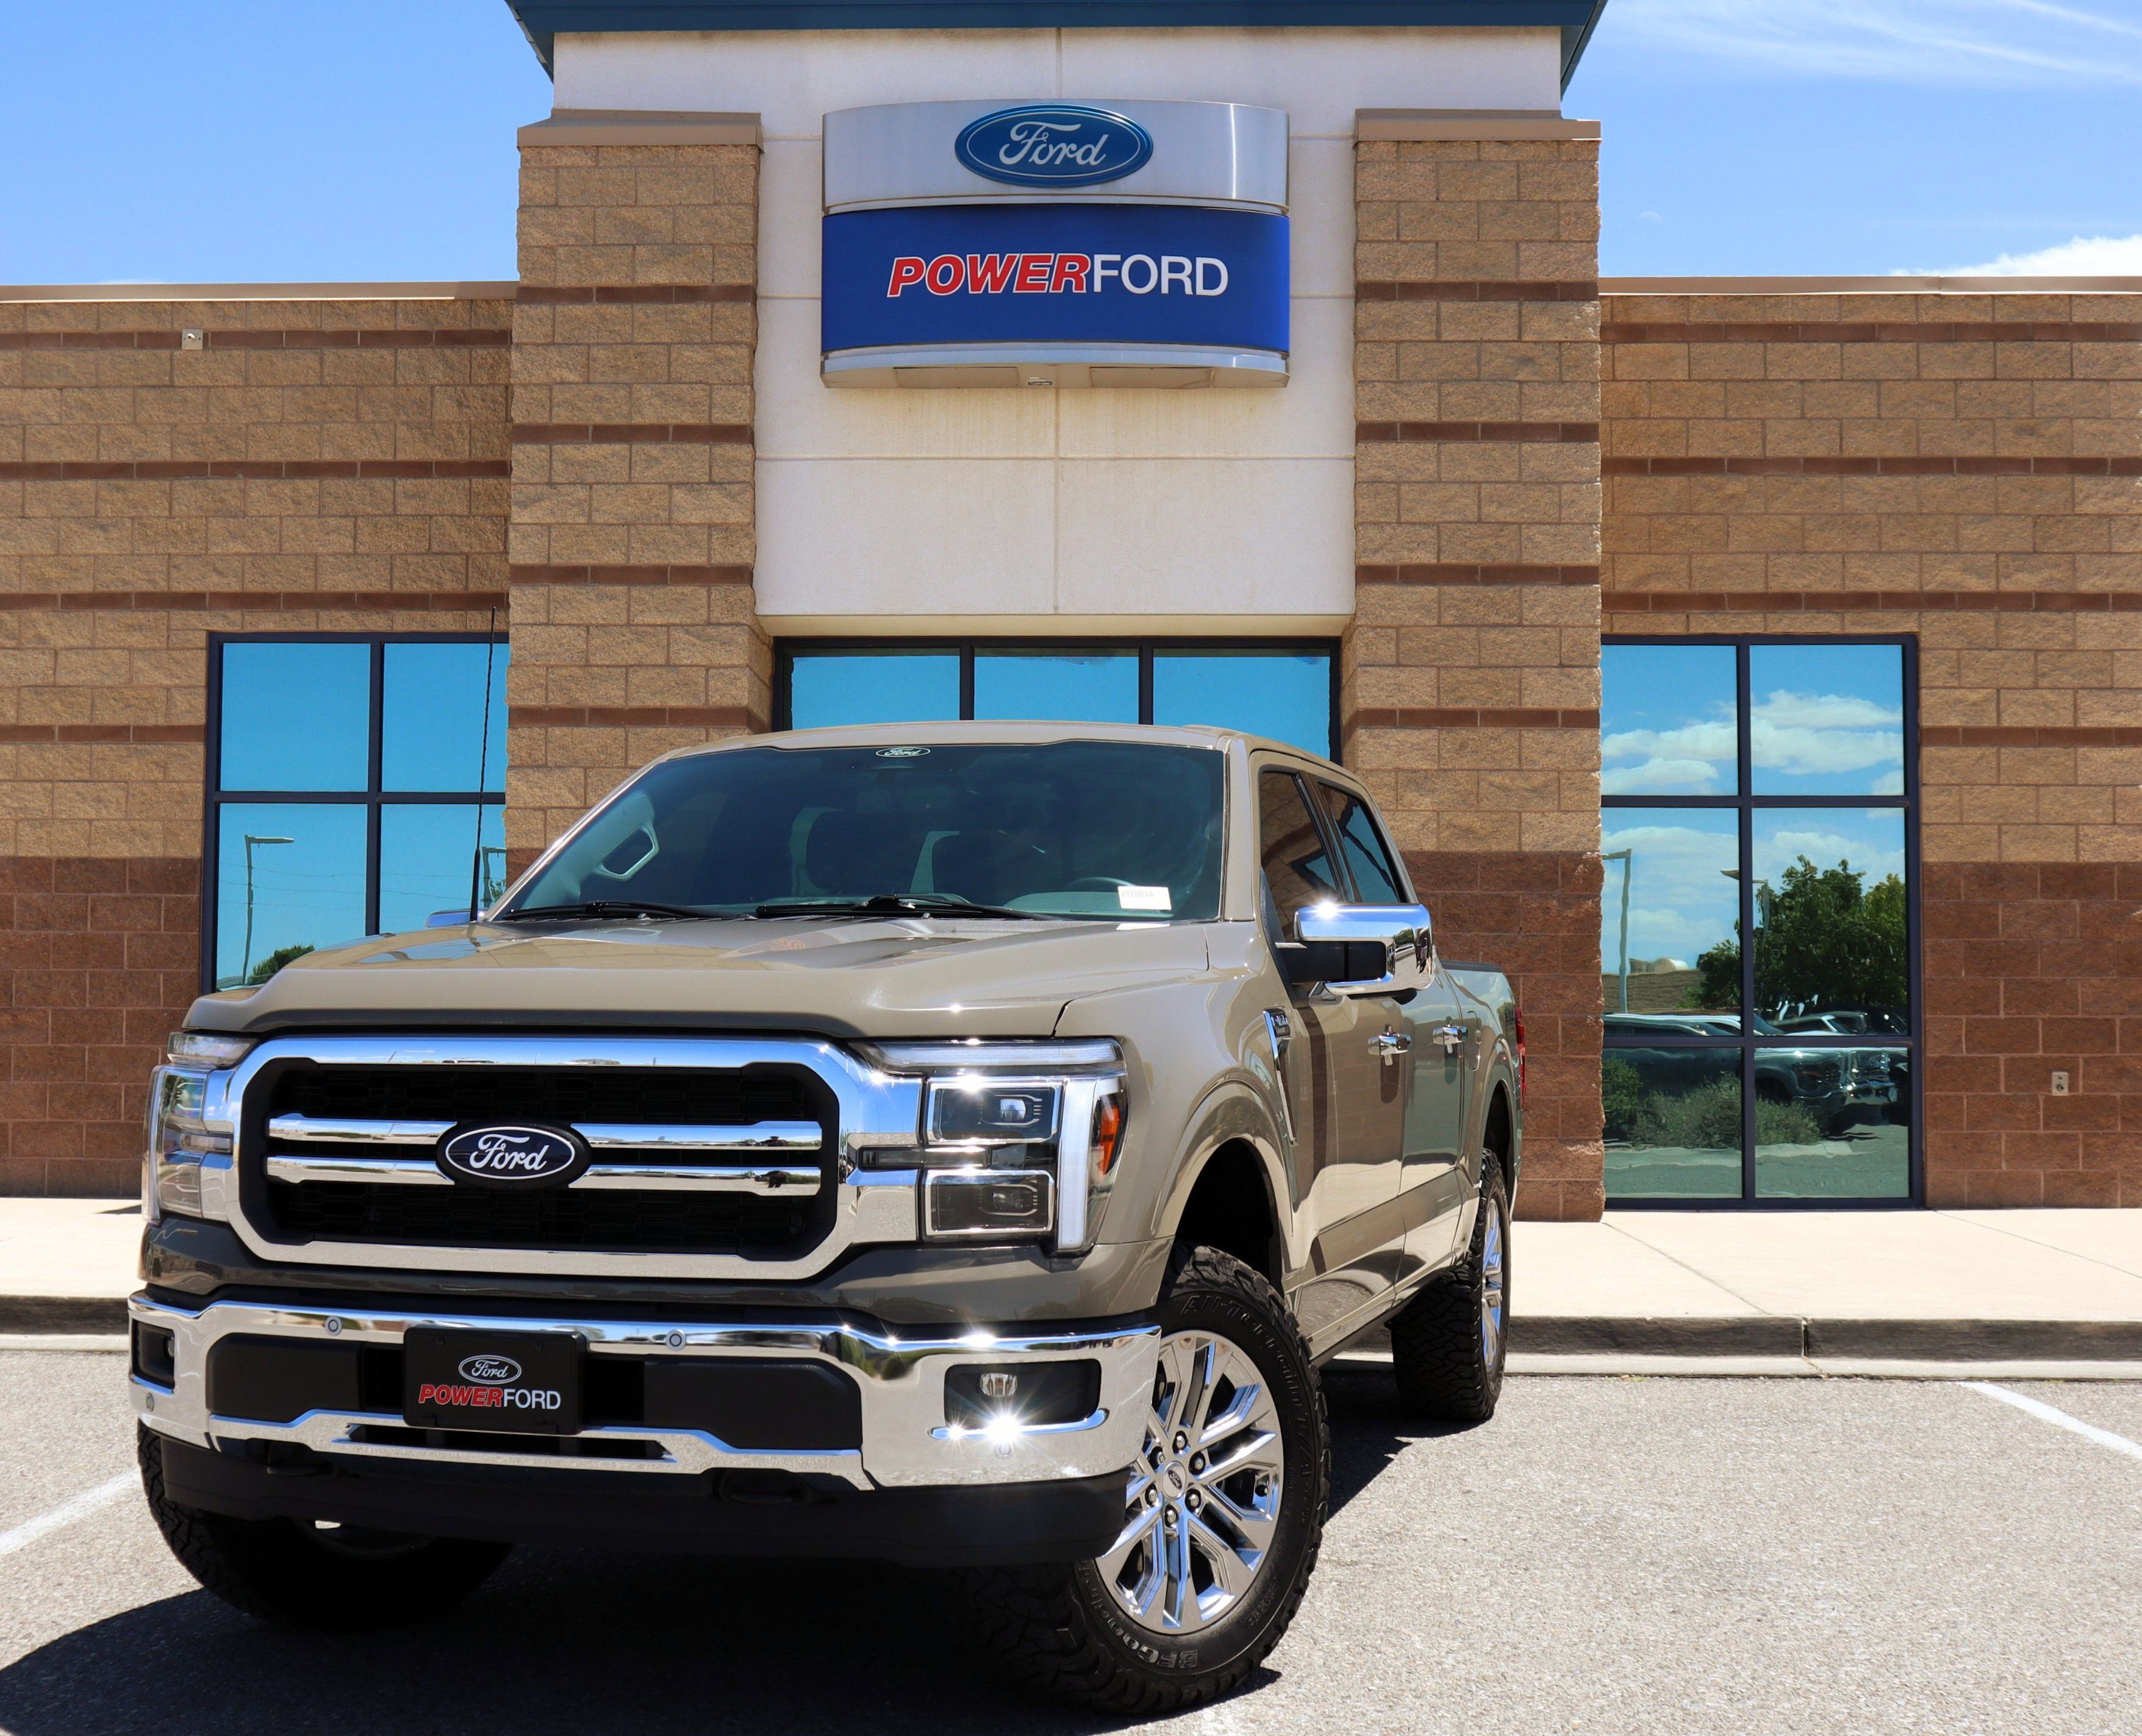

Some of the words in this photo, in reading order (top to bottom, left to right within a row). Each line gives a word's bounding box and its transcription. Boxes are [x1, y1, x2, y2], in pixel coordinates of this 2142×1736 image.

[998, 121, 1109, 167] Ford
[470, 1134, 550, 1171] Ford
[471, 1359, 509, 1379] Ford
